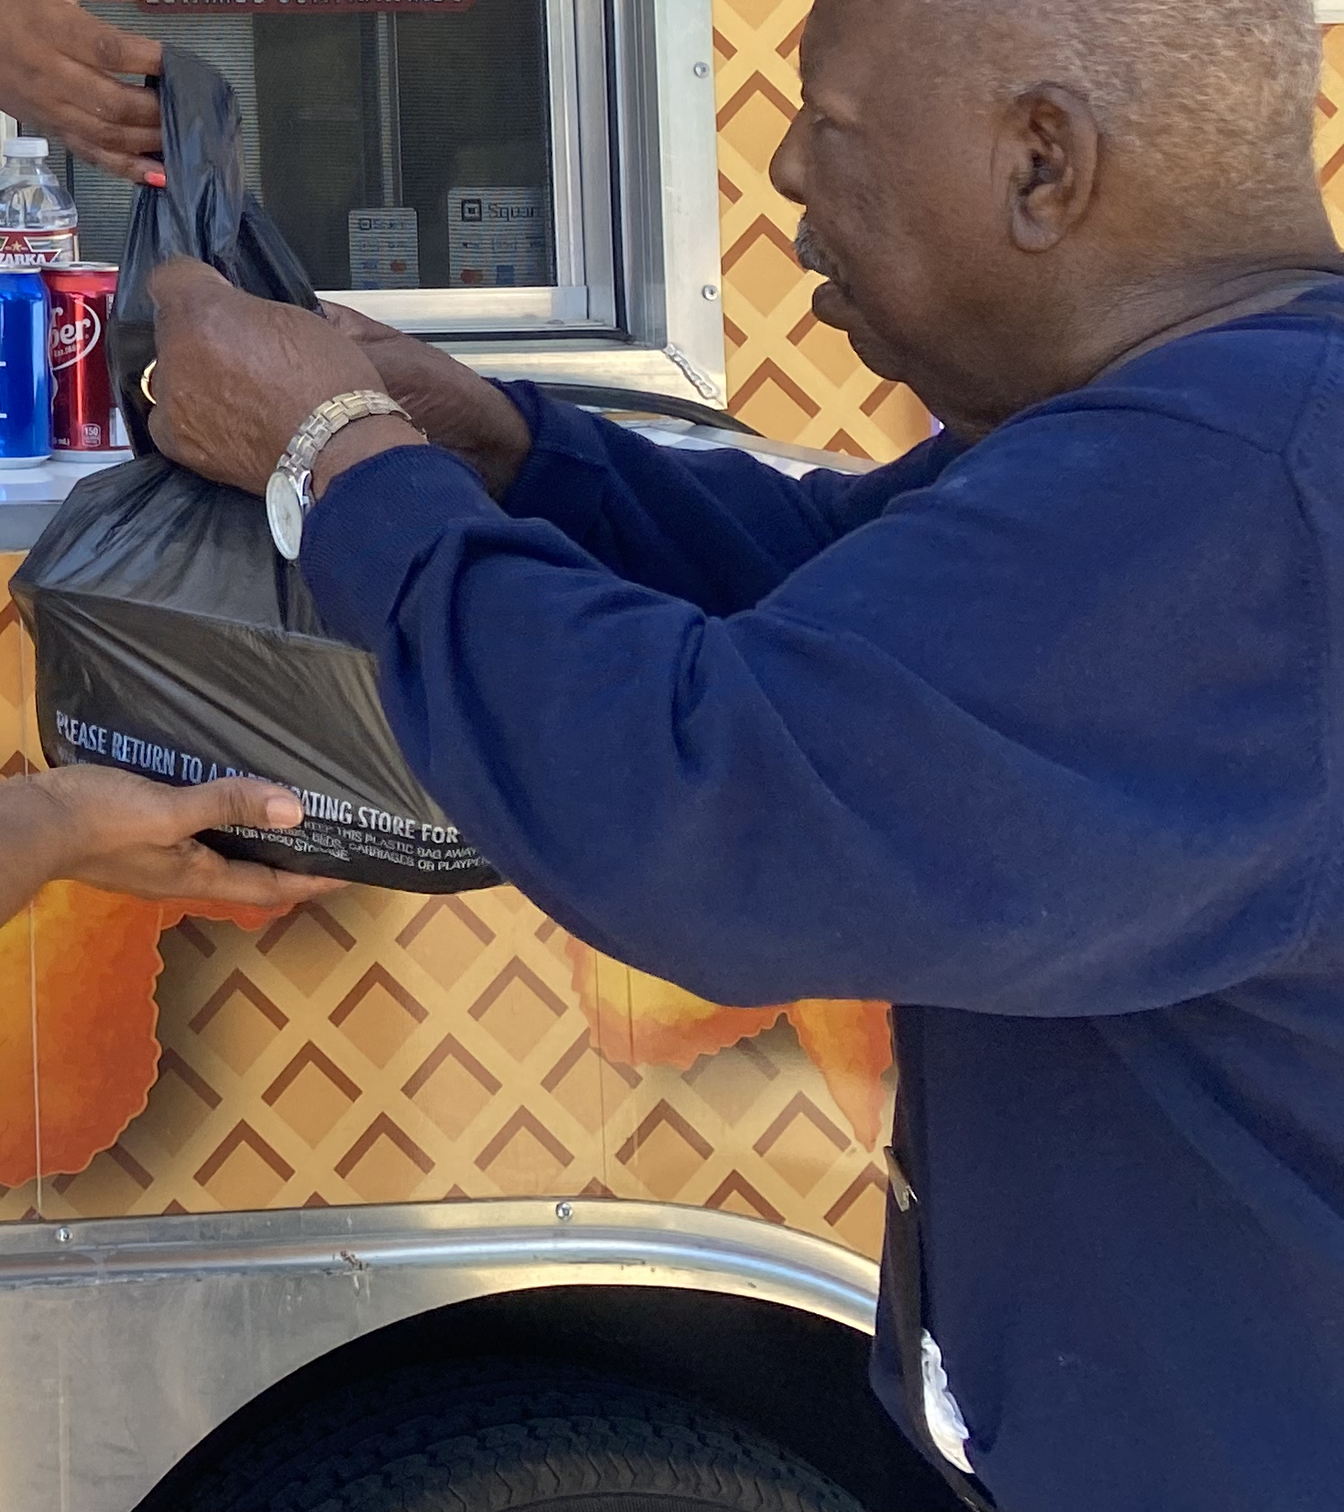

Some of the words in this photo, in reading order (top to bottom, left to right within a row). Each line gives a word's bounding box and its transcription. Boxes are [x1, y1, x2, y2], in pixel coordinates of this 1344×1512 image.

[84, 426, 99, 437] 150
[56, 709, 108, 755] PLEASE
[112, 732, 176, 777] RETURN
[180, 753, 203, 785] TO
[358, 804, 416, 840] STORE
[422, 823, 461, 845] FOR
[336, 826, 363, 844] THIS
[365, 831, 415, 855] PLASTIC
[444, 846, 478, 860] AWAY
